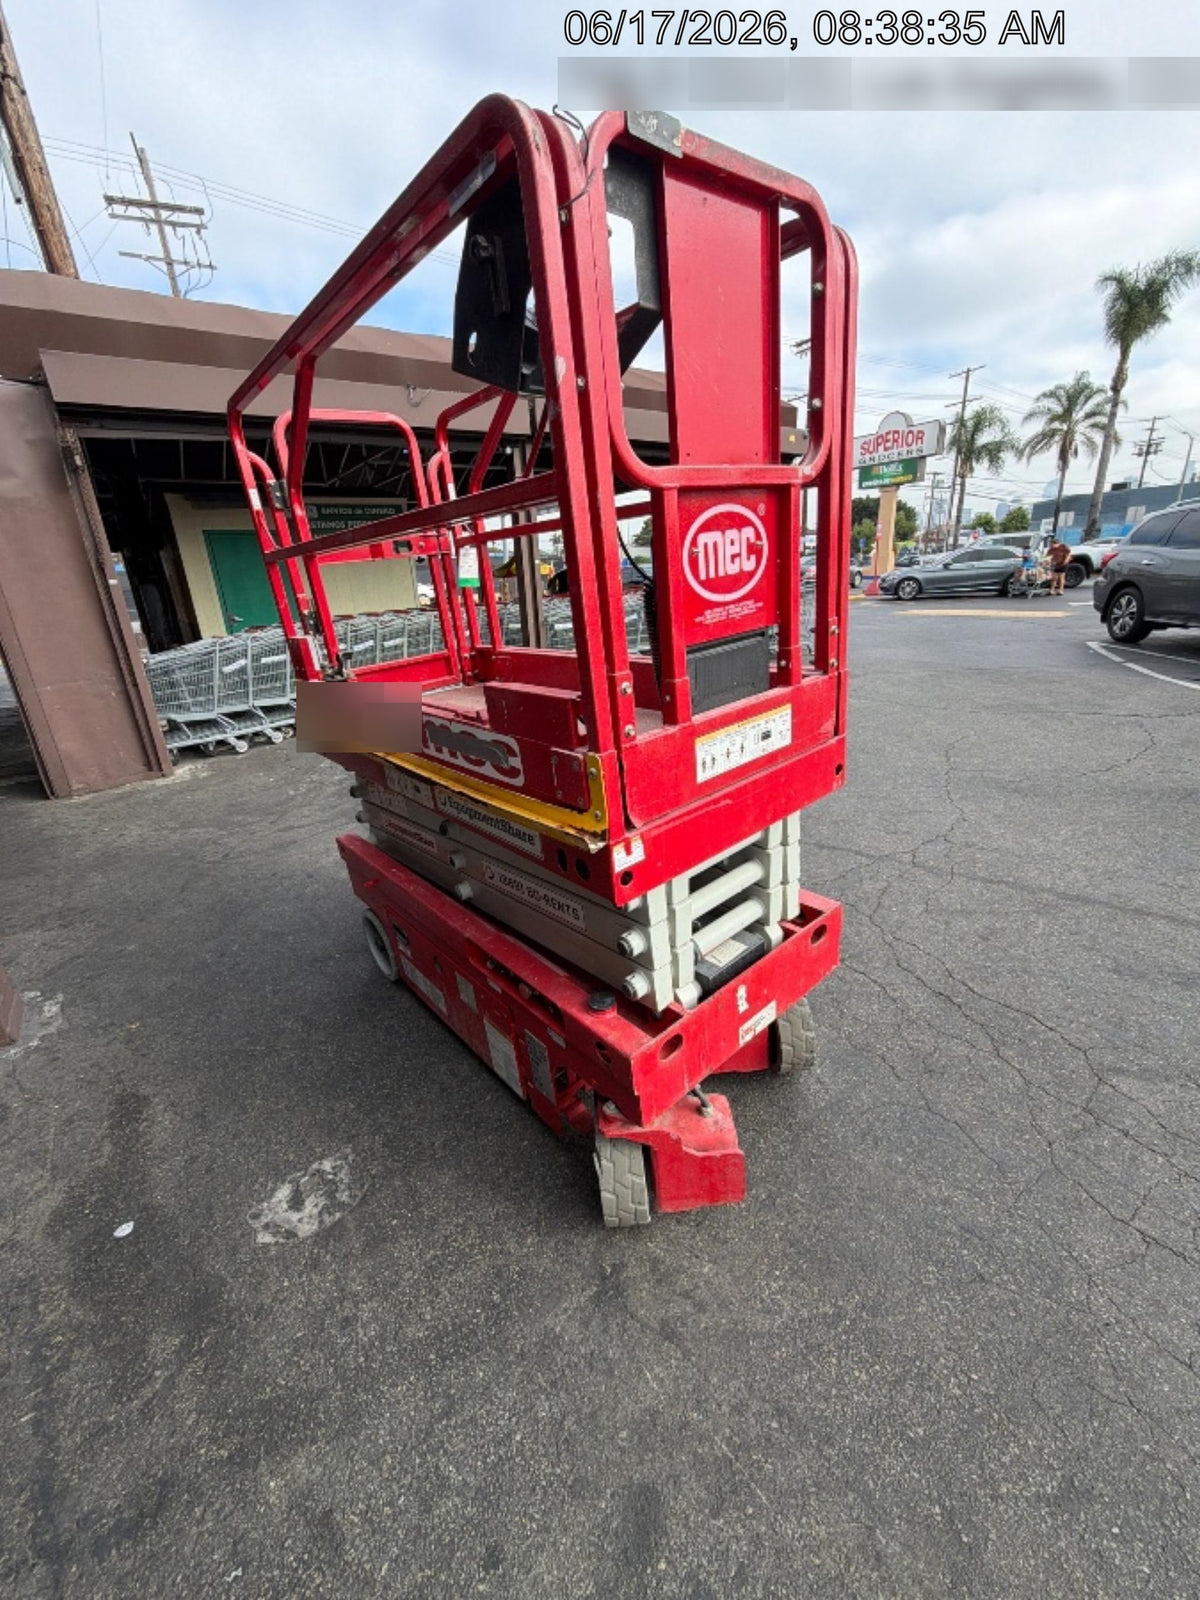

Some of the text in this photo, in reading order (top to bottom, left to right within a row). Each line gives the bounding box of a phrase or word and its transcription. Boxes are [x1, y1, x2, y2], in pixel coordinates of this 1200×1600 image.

[858, 447, 924, 465] GROCERS
[860, 429, 925, 456] SUPERIOR
[697, 526, 757, 581] mec
